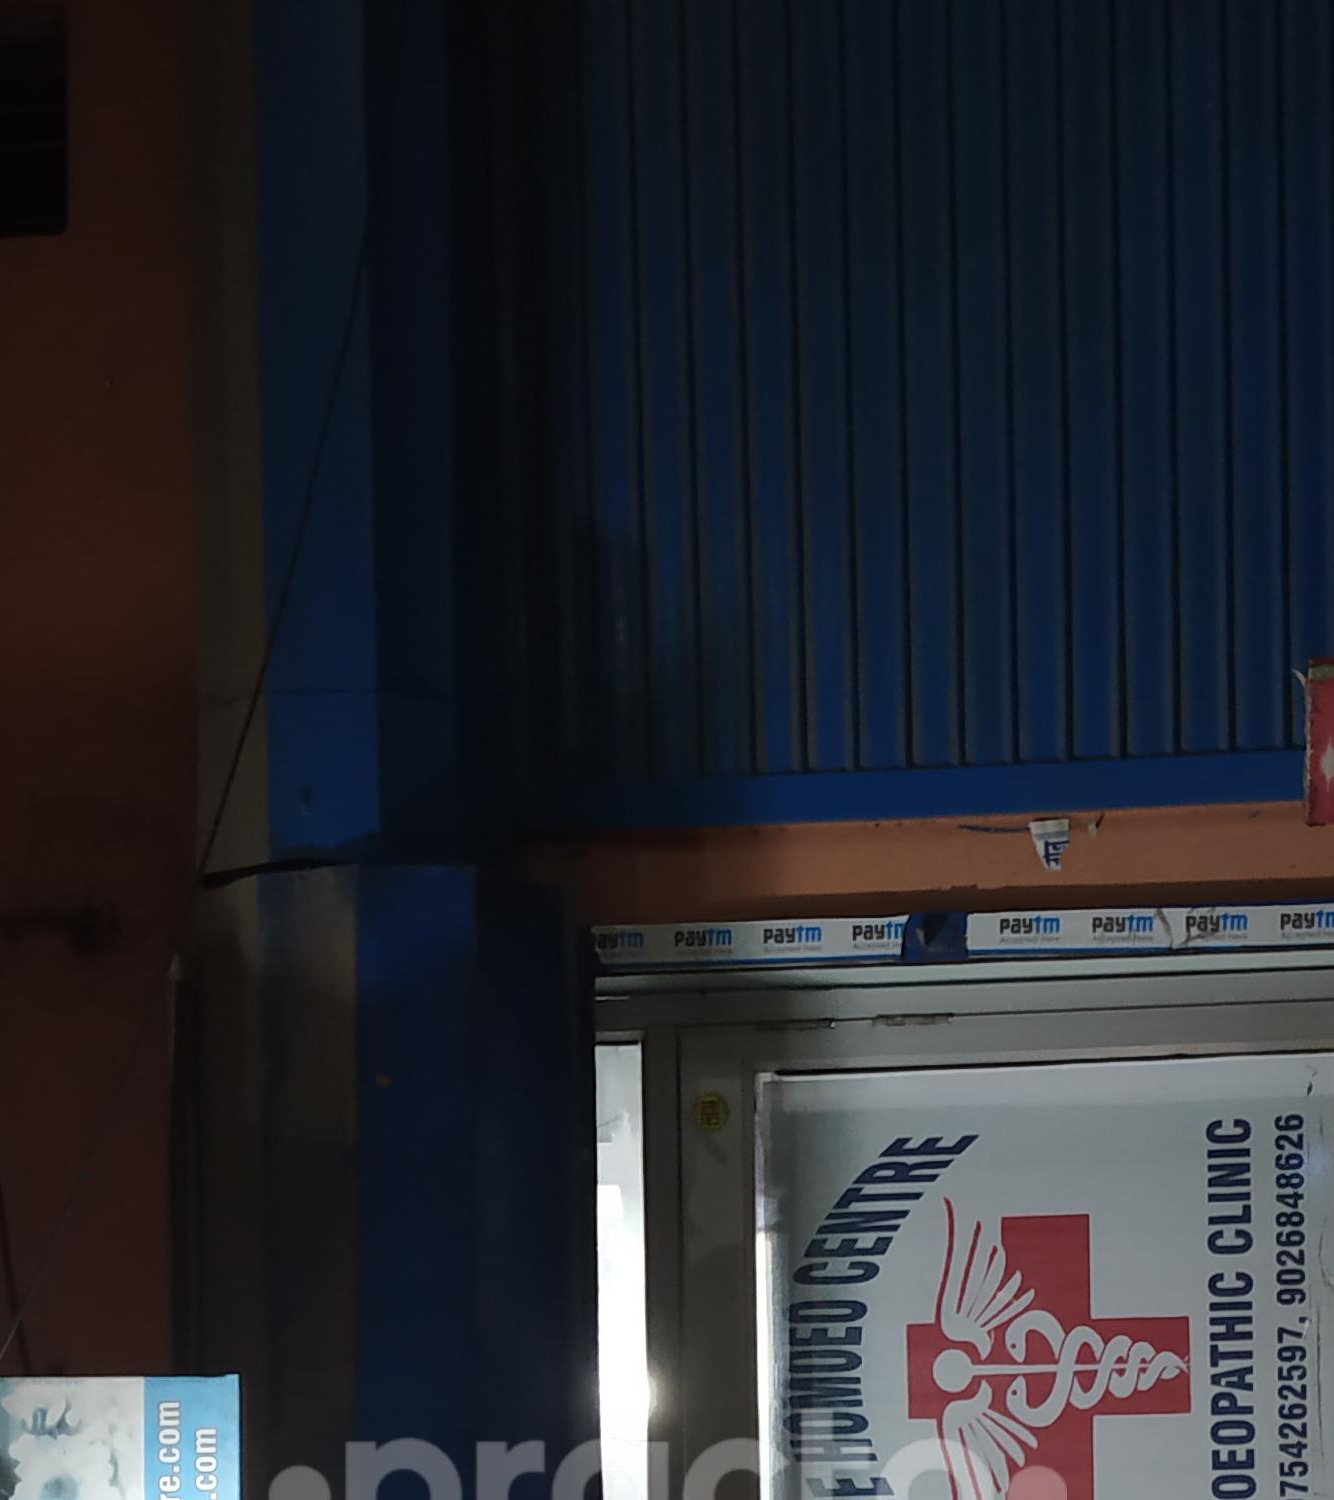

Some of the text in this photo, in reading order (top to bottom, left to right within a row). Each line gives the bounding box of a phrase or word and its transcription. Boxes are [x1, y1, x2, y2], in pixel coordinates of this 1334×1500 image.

[792, 1134, 980, 1286] CENTRE
[1205, 1118, 1253, 1256] CLINIC
[1274, 1114, 1306, 1306] 9026848626
[782, 1299, 878, 1463] HOMOEO
